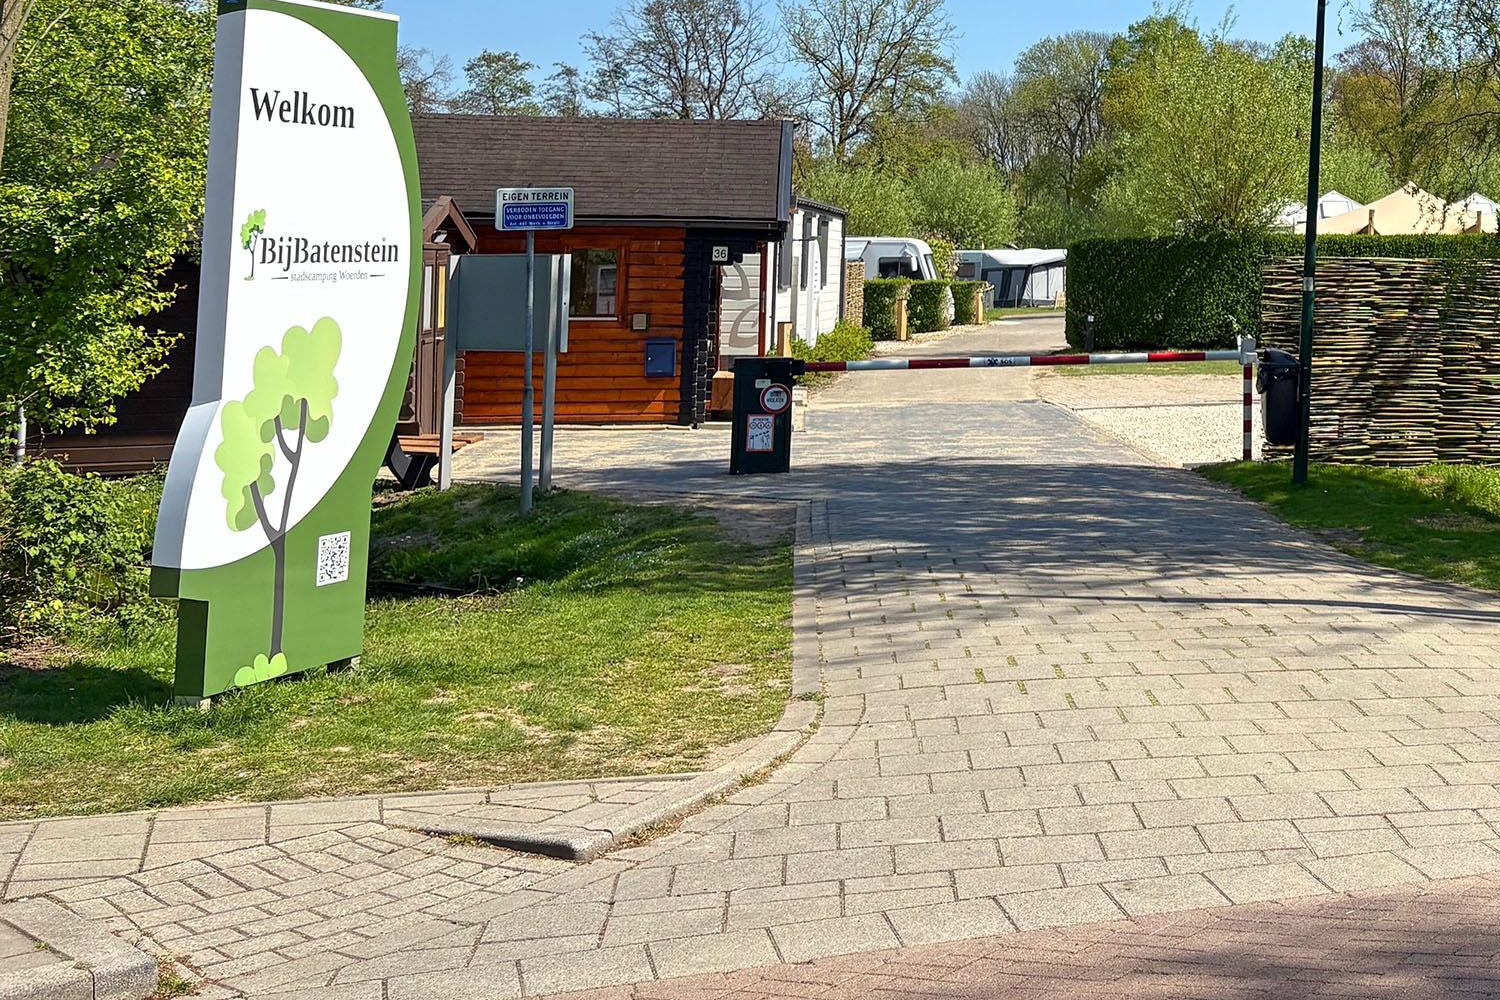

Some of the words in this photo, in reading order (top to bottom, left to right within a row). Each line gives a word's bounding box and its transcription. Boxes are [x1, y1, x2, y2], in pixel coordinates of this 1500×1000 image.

[249, 87, 355, 129] Welkom
[503, 193, 529, 201] EIGEN
[532, 192, 569, 200] TERREIN
[260, 236, 399, 272] BijBatenstein
[714, 249, 727, 259] 36
[290, 271, 337, 283] stadscamping
[339, 270, 368, 280] Woerden
